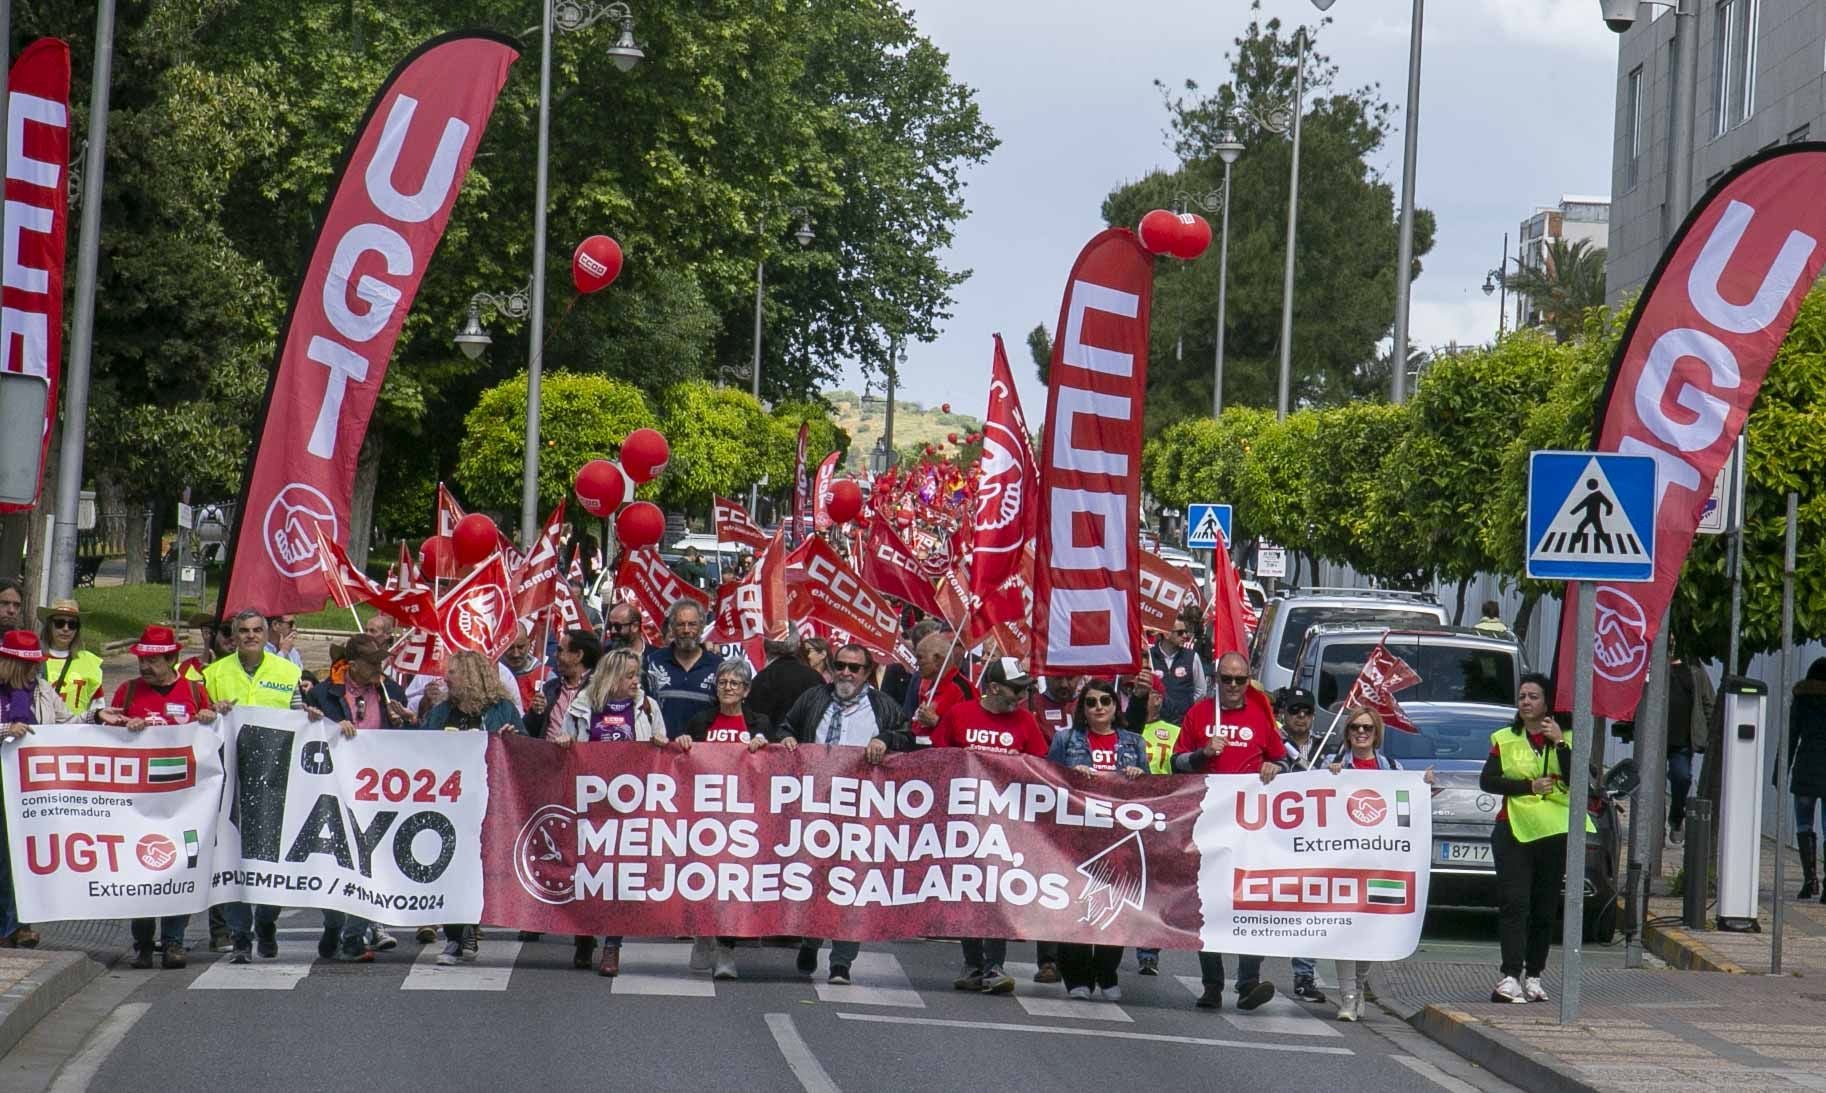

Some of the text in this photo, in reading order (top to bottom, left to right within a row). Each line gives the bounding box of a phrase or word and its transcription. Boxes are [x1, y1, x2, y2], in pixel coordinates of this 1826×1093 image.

[580, 254, 605, 275] CCOO
[306, 94, 469, 459] UGT
[1046, 279, 1139, 666] CCOO
[808, 555, 898, 634] CCOO
[707, 730, 738, 741] UGT
[966, 729, 999, 744] UGT
[1205, 725, 1239, 739] UGT
[1092, 750, 1113, 763] GT
[28, 755, 141, 784] CCOO
[355, 767, 462, 803] 2024
[21, 793, 133, 807] comisiones obreras
[575, 773, 1167, 832] POR EL PLENO EMPLEO:
[1235, 788, 1337, 831] UGT
[22, 807, 111, 818] de extremadura
[576, 818, 1024, 866] MENOS JORNADA,
[1293, 835, 1411, 853] Extremadura
[1452, 845, 1490, 860] 8717
[26, 832, 125, 875] UGT
[89, 878, 195, 897] Extremadura
[574, 862, 1070, 910] MEJORES SALARIOS
[1242, 876, 1359, 904] CCOO
[1232, 914, 1353, 926] comisiones obreras
[1232, 927, 1328, 938] de extremadura
